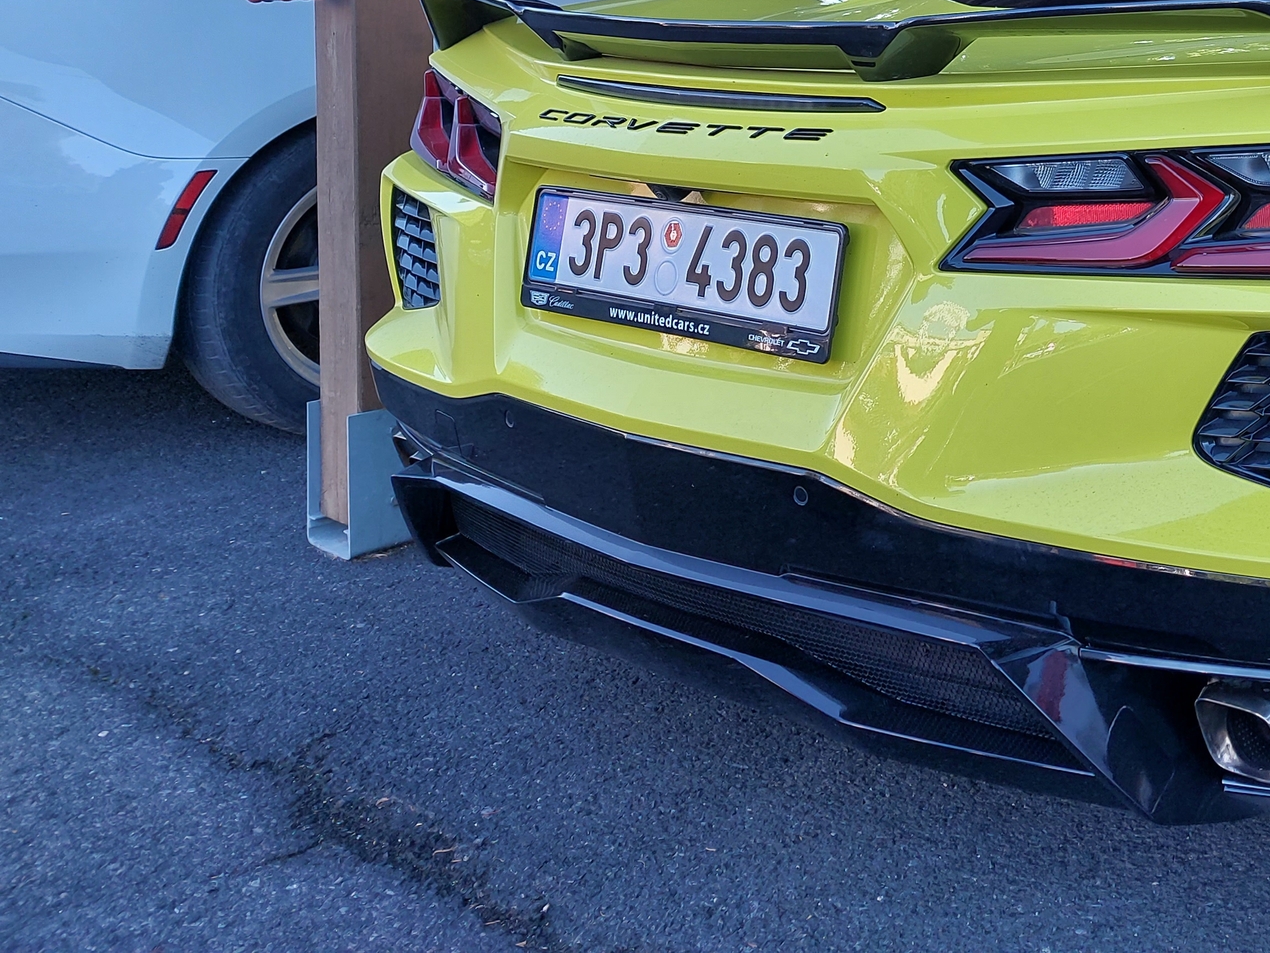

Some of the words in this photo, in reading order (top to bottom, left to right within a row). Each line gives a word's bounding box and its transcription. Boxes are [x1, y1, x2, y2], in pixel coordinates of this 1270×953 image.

[539, 108, 834, 142] CORVETTE
[535, 250, 557, 272] CZ
[568, 209, 652, 286] 3P3
[686, 225, 811, 312] 4383
[549, 295, 575, 309] Cadillac
[609, 305, 711, 336] www.unitedcars.cz
